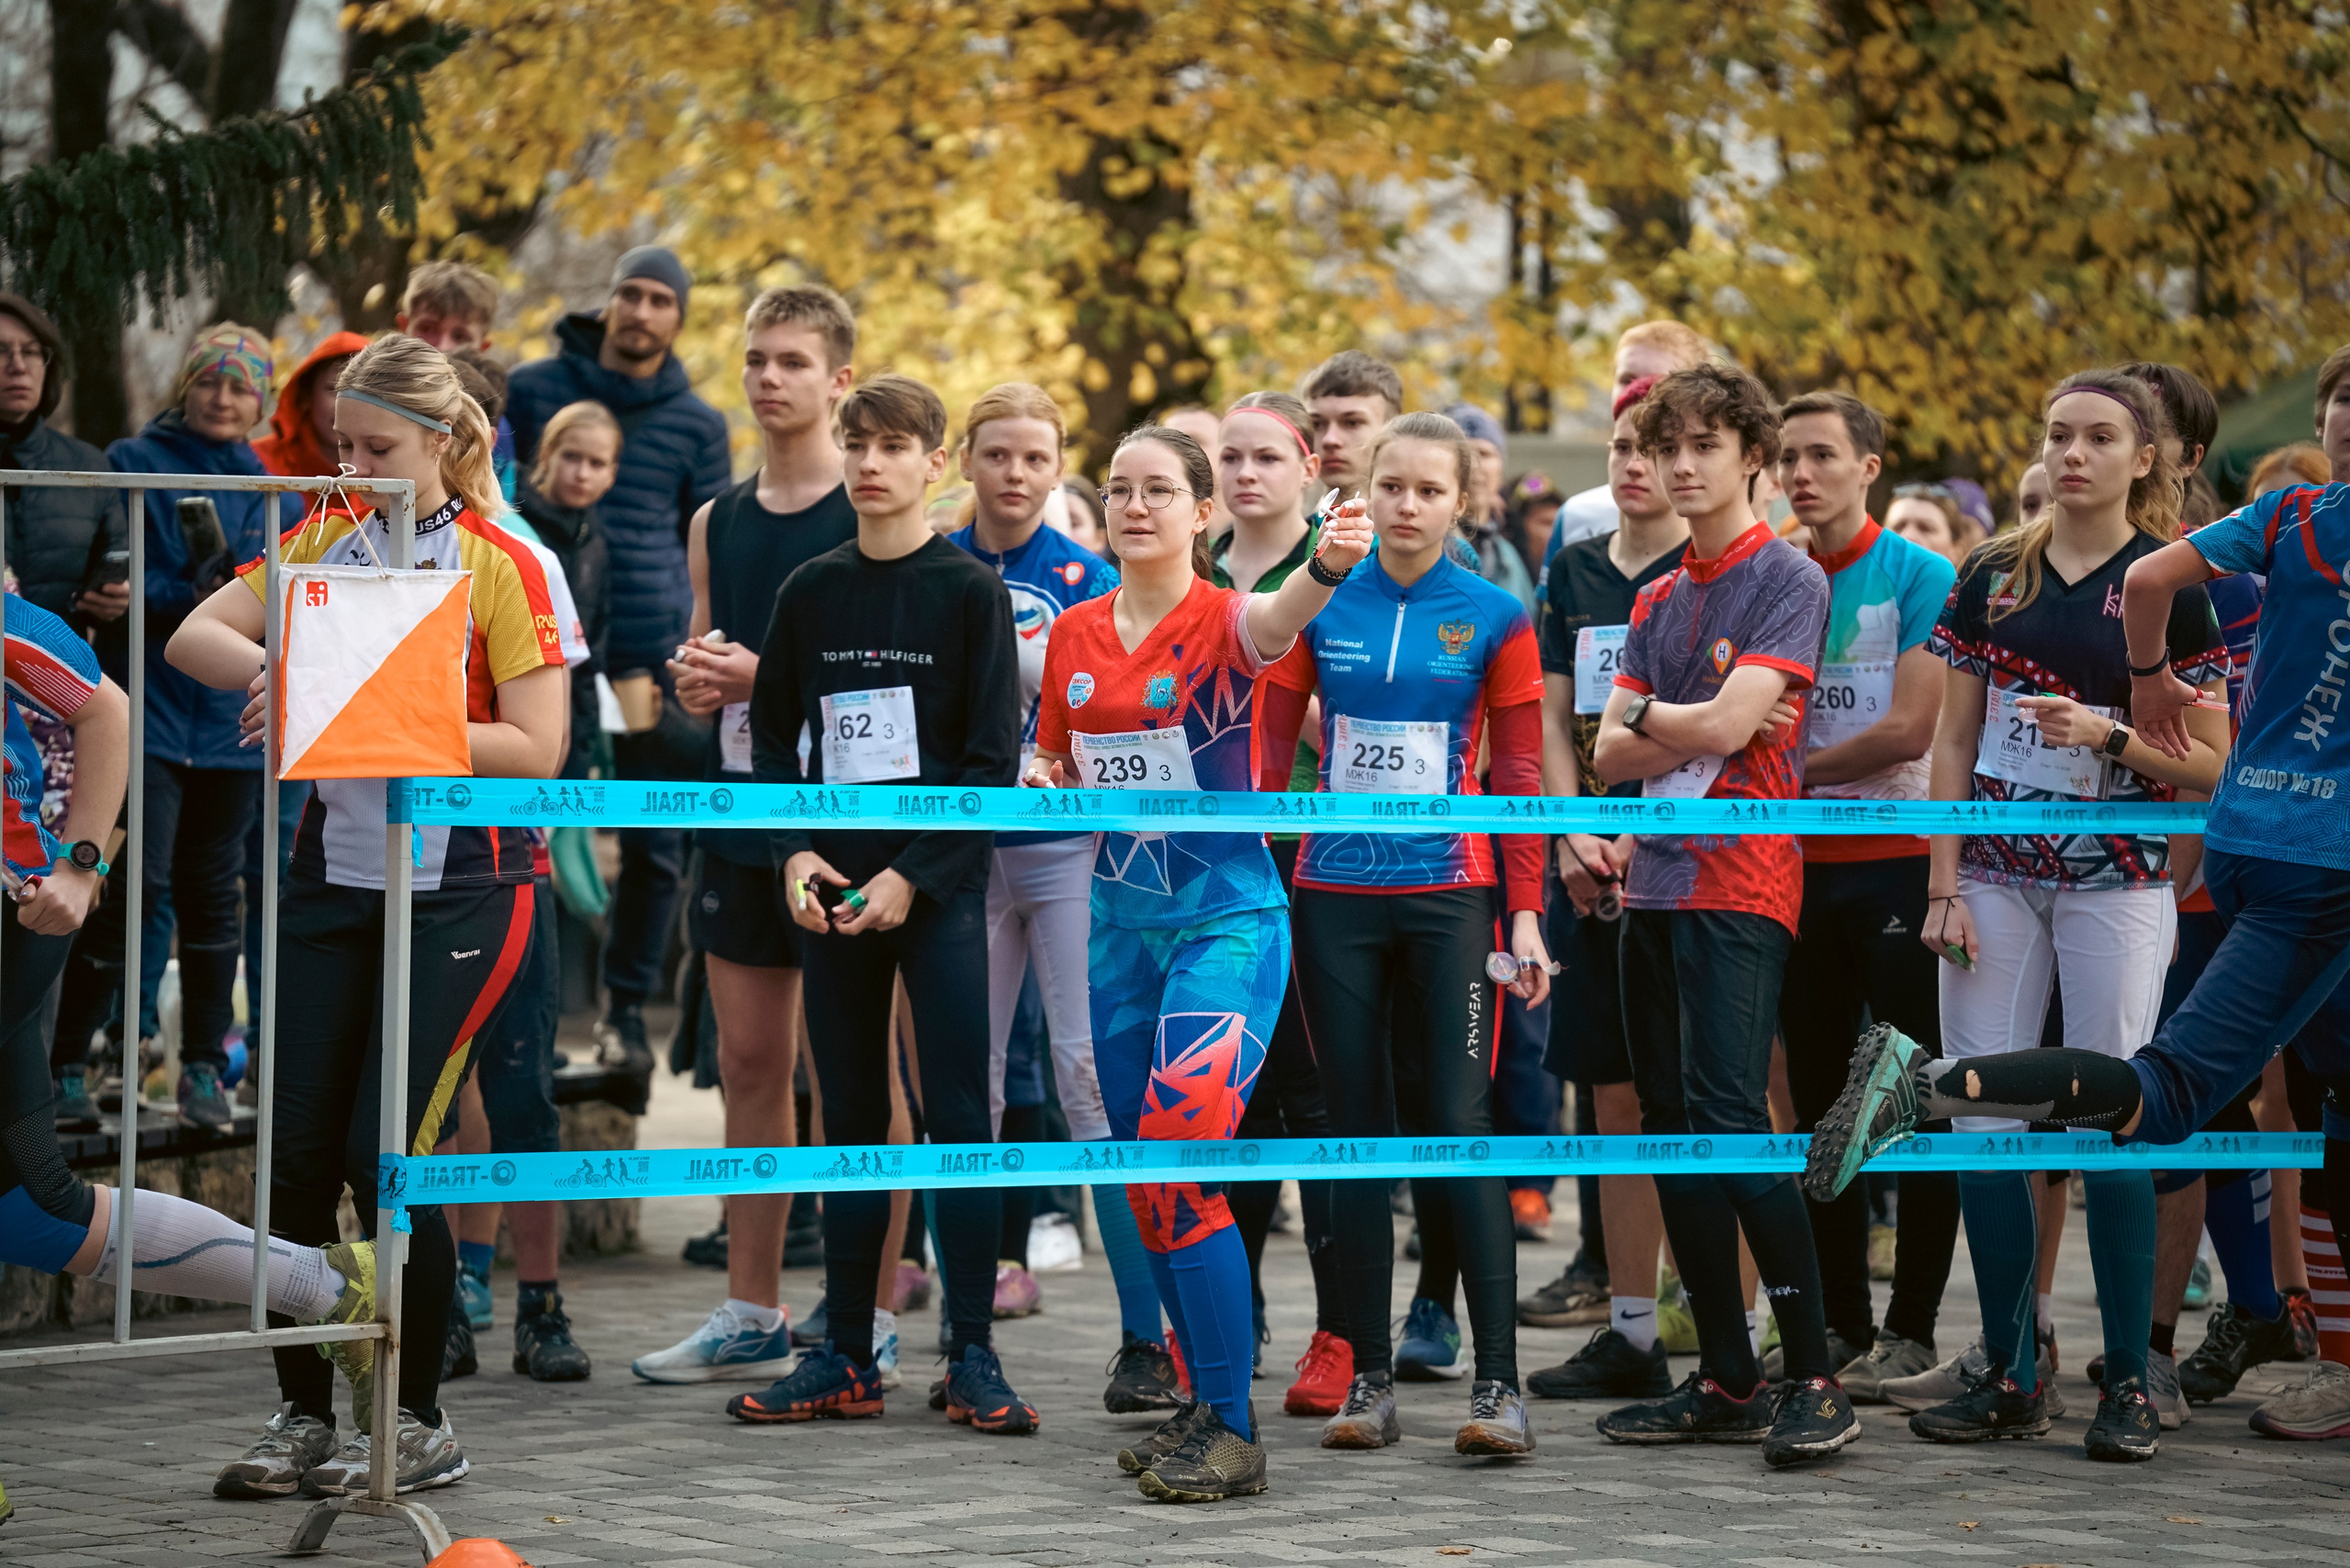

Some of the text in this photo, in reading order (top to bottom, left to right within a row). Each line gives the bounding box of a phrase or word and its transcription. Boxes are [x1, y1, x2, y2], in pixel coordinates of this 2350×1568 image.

[415, 508, 452, 533] US46
[535, 614, 558, 630] RUS
[1325, 638, 1363, 648] National
[822, 650, 933, 665] TOMMY HILFIGER
[1317, 650, 1371, 663] Orienteering
[1427, 661, 1474, 669] ORIENTEERING
[1330, 663, 1352, 672] Team
[1814, 686, 1877, 711] 260 3
[834, 712, 895, 741] 62 3
[1082, 734, 1141, 745] ПЕРВЕНСТВО РОССИИ
[2001, 740, 2032, 758] МЖ16
[1352, 742, 1426, 775] 225 3
[1093, 754, 1171, 783] 239 3
[1346, 768, 1378, 782] МЖ16
[1695, 761, 1706, 778] 3
[2236, 766, 2288, 791] СШОР
[1467, 982, 1482, 1059] ARSWEAR
